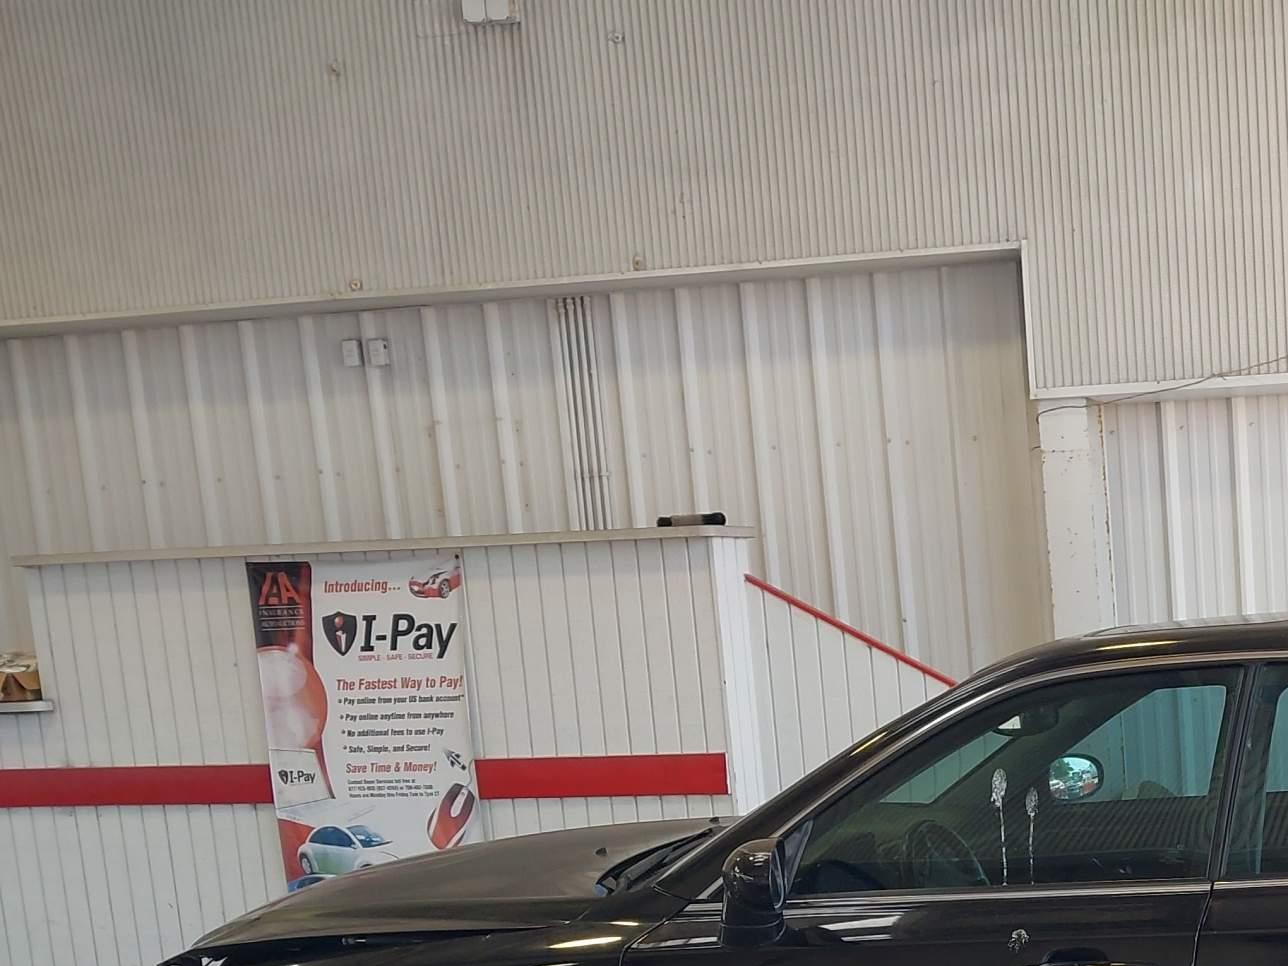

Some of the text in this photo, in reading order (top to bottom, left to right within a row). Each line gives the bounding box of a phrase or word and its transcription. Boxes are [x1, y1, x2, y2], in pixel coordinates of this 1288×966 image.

[324, 579, 400, 594] Introducing...
[360, 613, 458, 659] I-Pay
[336, 674, 463, 691] The Fastest Way to Pay!
[344, 697, 355, 706] Pay
[357, 696, 376, 705] online
[378, 696, 392, 704] from
[393, 696, 407, 705] your
[409, 695, 417, 703] US
[418, 695, 433, 703] bank
[345, 710, 454, 722] Pay online anytime from anywhere
[347, 727, 444, 737] No additional fees to use I-Pay
[349, 743, 431, 754] Safe, Simple, and Secure!
[346, 761, 437, 774] Save Time & Money!
[289, 770, 315, 784] I-Pay
